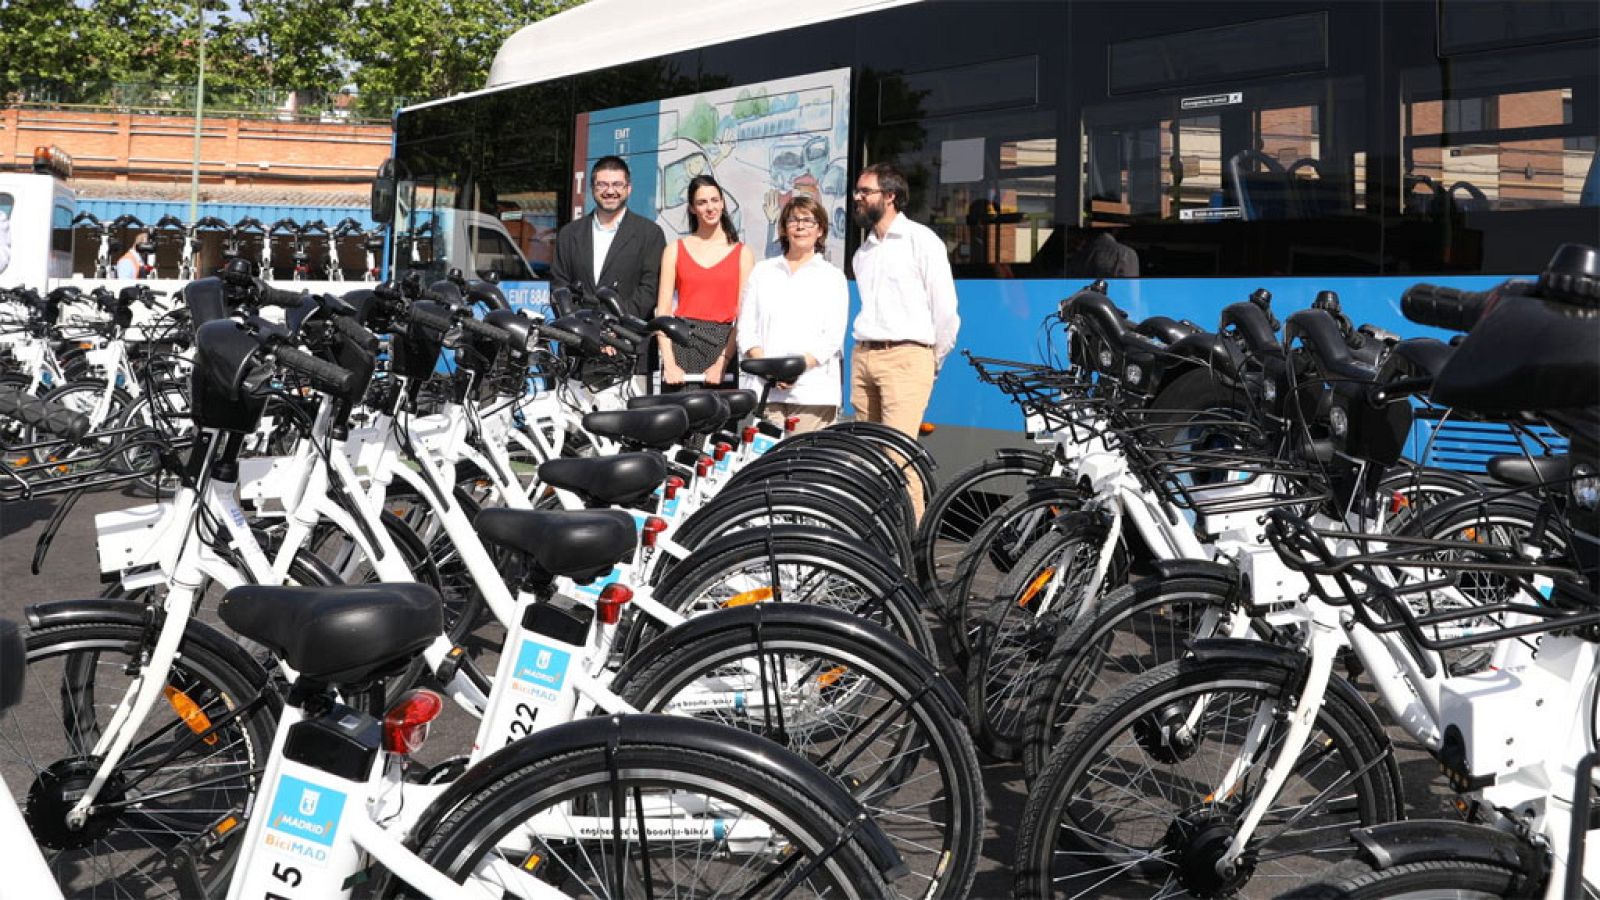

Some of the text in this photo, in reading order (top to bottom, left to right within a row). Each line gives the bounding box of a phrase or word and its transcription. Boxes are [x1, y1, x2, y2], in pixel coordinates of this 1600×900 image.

[615, 128, 631, 140] EMT
[509, 289, 529, 305] EMT
[265, 833, 326, 861] BiciMAD
